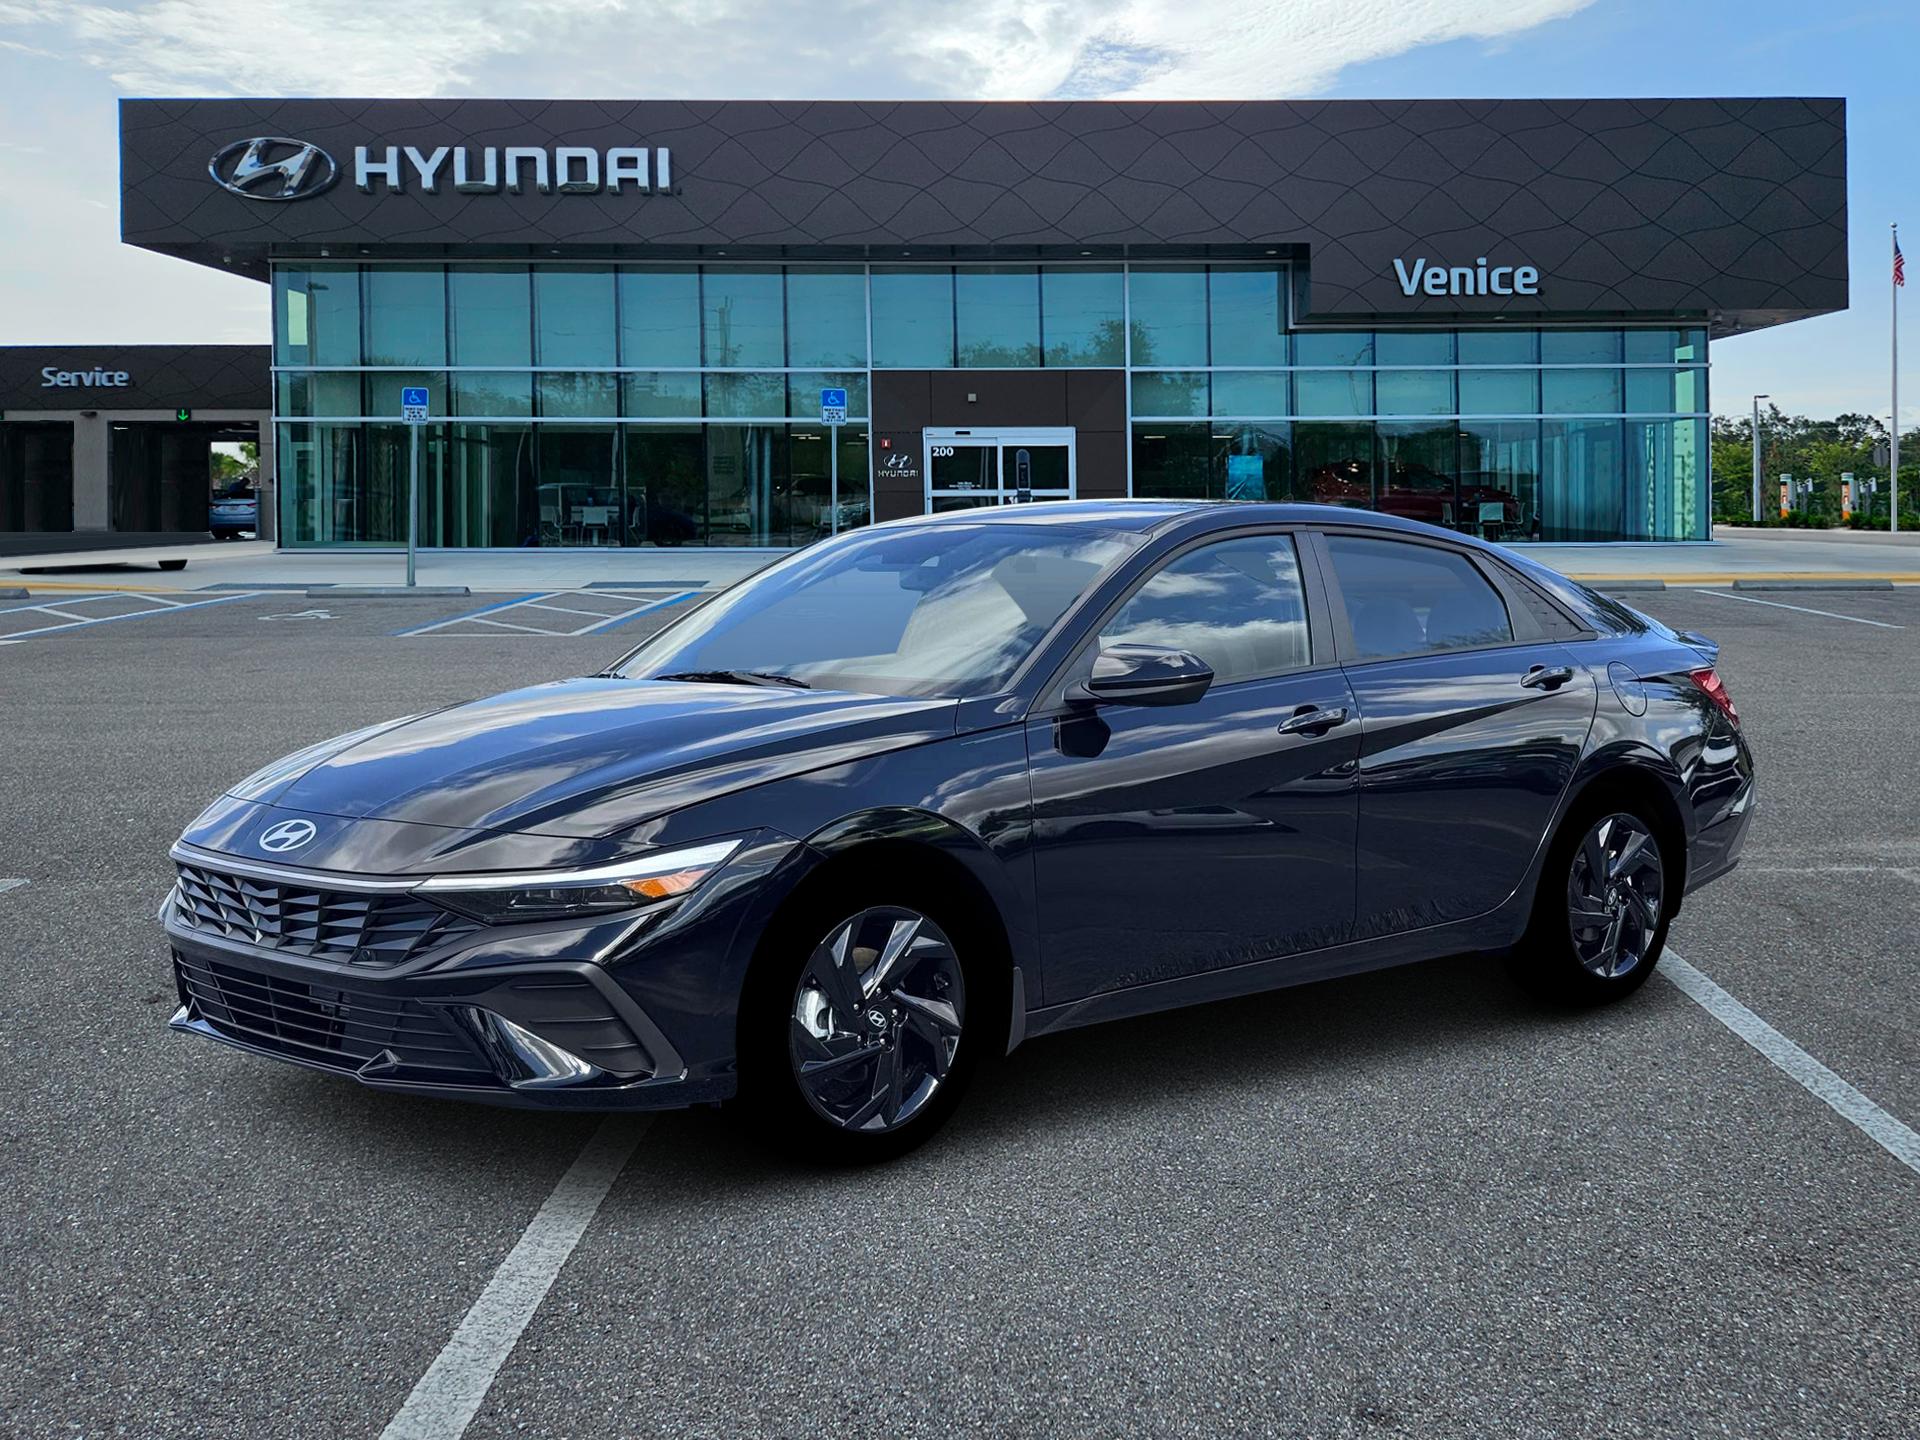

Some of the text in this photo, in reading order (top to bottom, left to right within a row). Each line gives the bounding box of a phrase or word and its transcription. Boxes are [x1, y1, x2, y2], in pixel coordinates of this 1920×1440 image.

[354, 146, 674, 194] HYUNDAI
[1393, 257, 1539, 295] Venice
[41, 366, 129, 387] Service
[932, 447, 954, 457] 200
[878, 470, 919, 478] HYUNDAI
